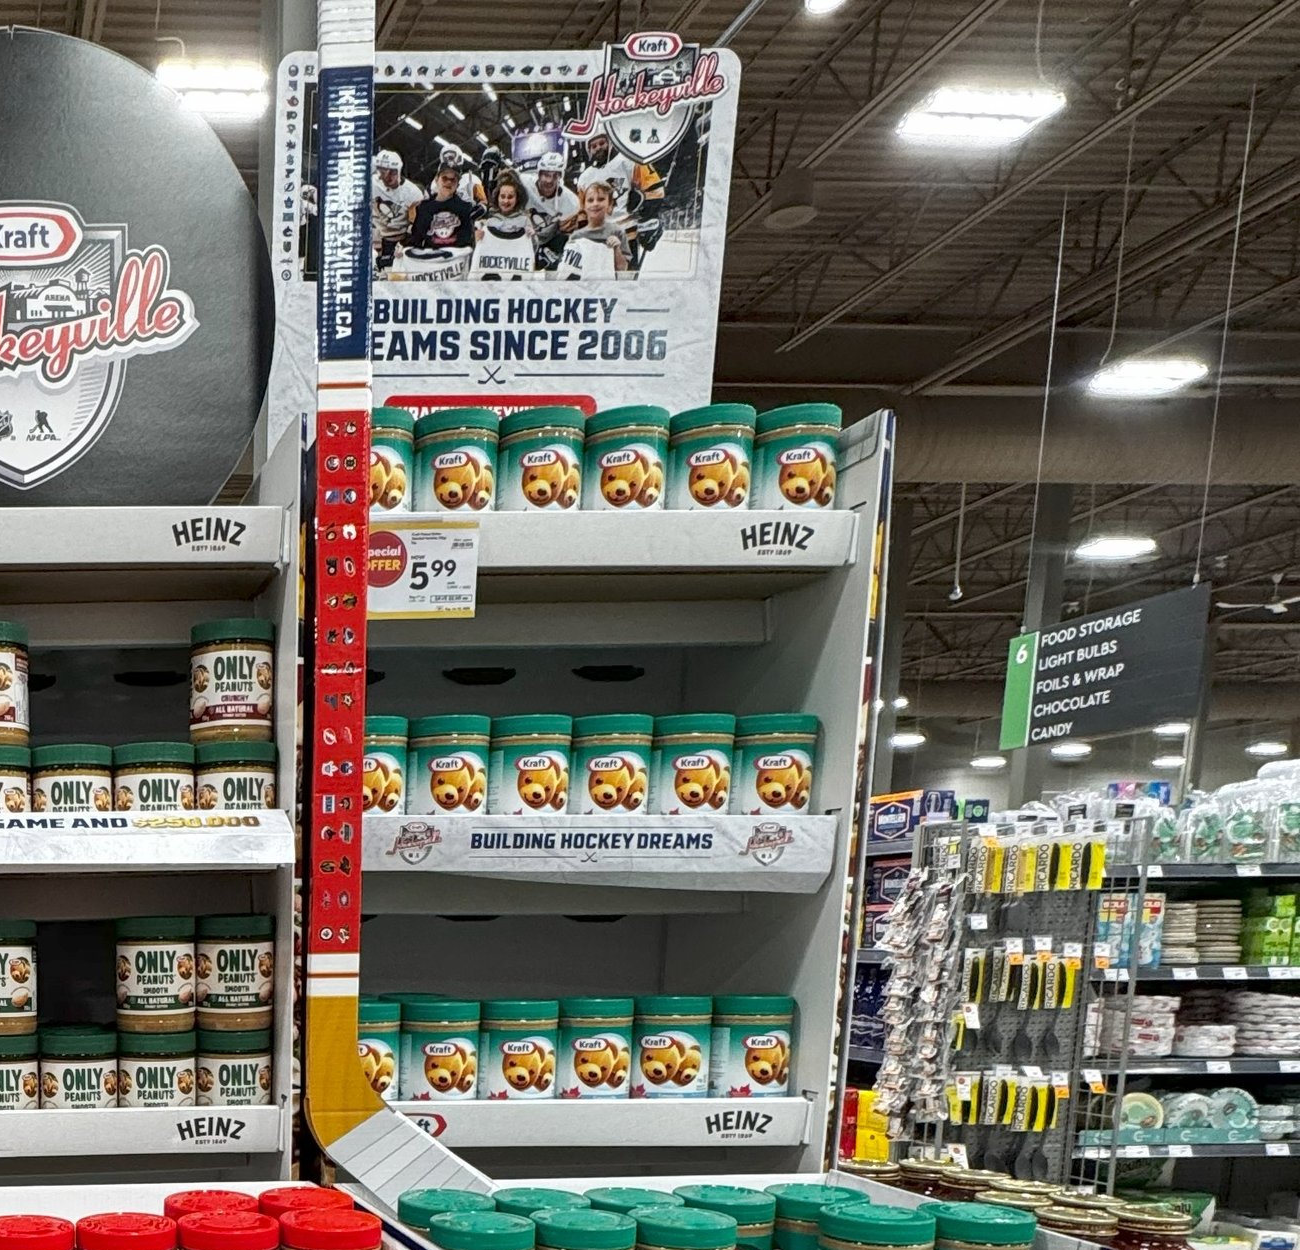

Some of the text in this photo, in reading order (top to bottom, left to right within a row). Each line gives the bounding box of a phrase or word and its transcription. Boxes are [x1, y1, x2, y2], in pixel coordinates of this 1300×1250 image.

[638, 38, 669, 52] Kraft
[568, 53, 724, 134] Hockeyville
[479, 256, 529, 271] HOCKEYVILLE
[373, 298, 617, 325] BUILDING HOCKEY
[373, 329, 667, 361] EAMS SINCE 2006
[172, 517, 246, 546] HEINZ
[741, 521, 815, 550] HEINZ
[1041, 608, 1142, 648] FOOD STORAGE
[1015, 643, 1028, 664] 6
[1038, 640, 1118, 671] LIGHT BULBS
[214, 656, 256, 681] ONLY
[1036, 664, 1125, 695] FOILS & WRAP
[215, 681, 253, 693] PEANUTS
[1034, 690, 1111, 718] CHOCOLATE
[1031, 722, 1073, 742] CANDY
[523, 758, 546, 769] Kraft
[71, 817, 128, 828] AND
[470, 832, 714, 850] BUILDING HOCKEY DREAMS
[1037, 844, 1049, 890] RICARDO
[1070, 843, 1082, 889] RICARDO
[177, 1116, 246, 1142] HEINZ
